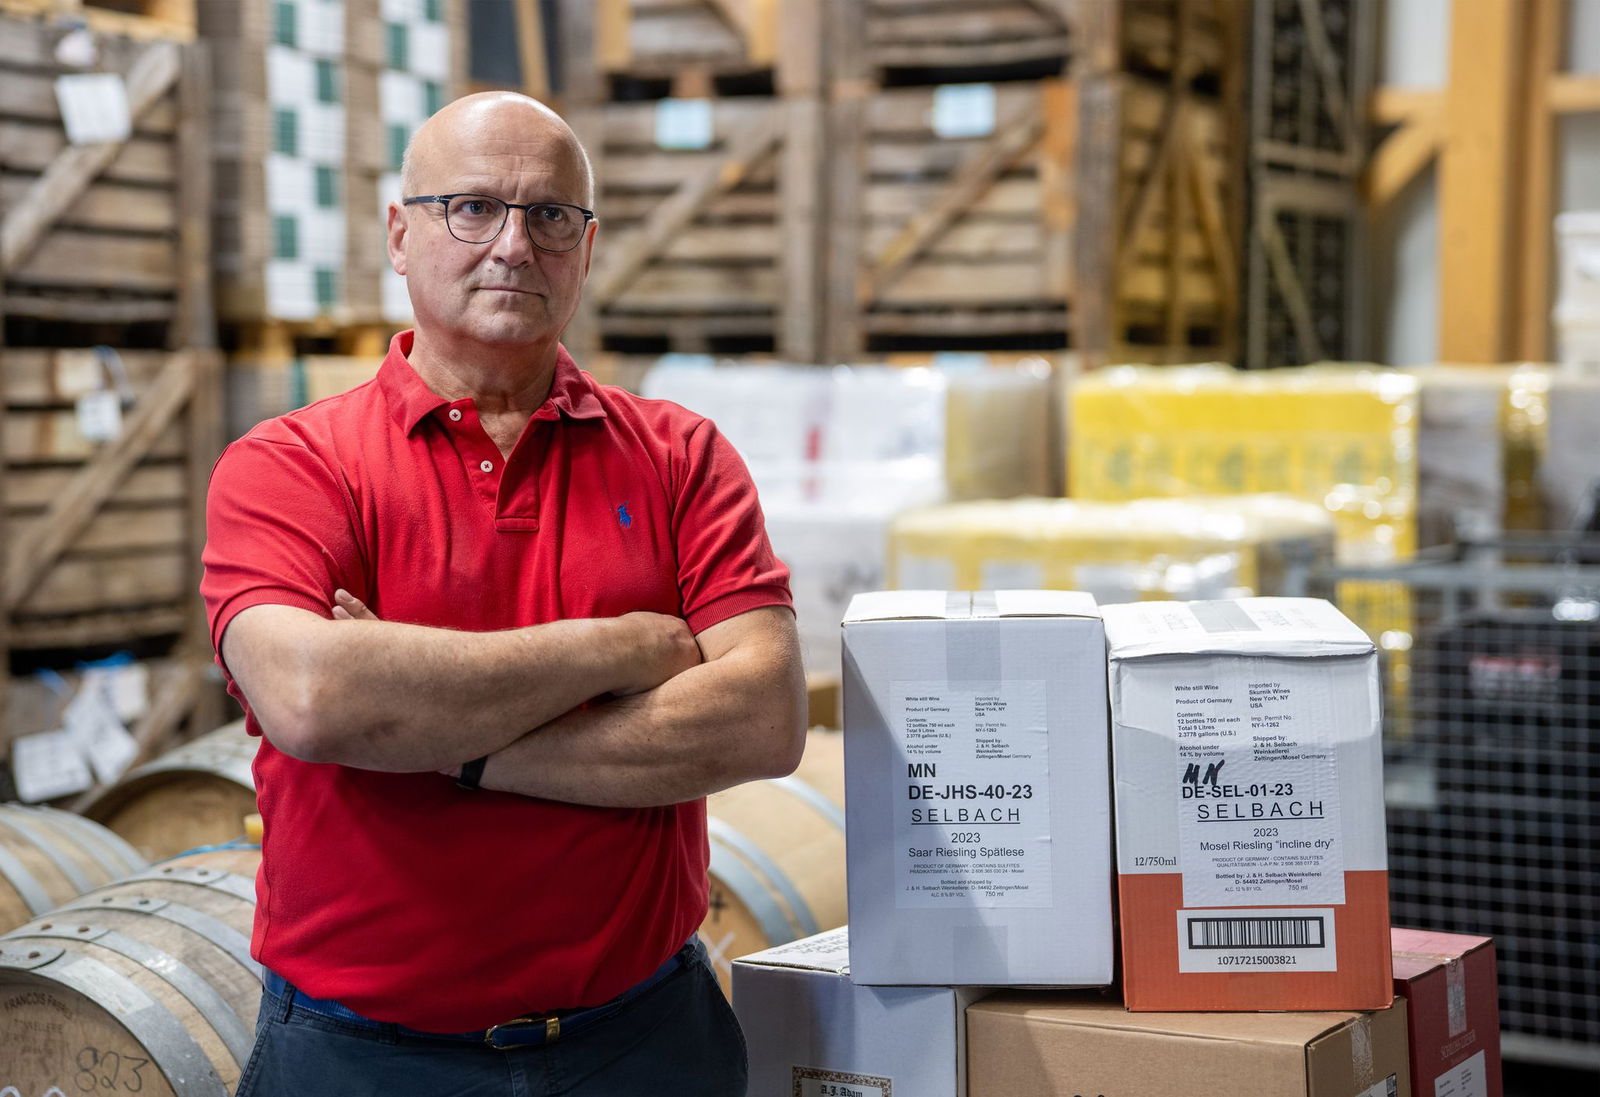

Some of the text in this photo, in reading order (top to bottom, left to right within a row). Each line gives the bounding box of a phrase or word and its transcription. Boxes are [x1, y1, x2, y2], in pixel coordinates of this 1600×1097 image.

[908, 763, 936, 778] MN
[908, 785, 1033, 800] DE-JHS-40-23
[1182, 783, 1294, 799] DE-SEL-01-23
[911, 808, 1020, 822] SELBACH
[1197, 801, 1323, 819] SELBACH
[951, 832, 981, 843] 2023
[1253, 828, 1279, 838] 2023
[1200, 841, 1230, 851] Mosel
[1233, 840, 1273, 851] Riesling
[908, 846, 1025, 859] Saar Riesling Spätlese
[1135, 856, 1177, 867] 12/750ml
[1217, 956, 1297, 965] 10717215003821
